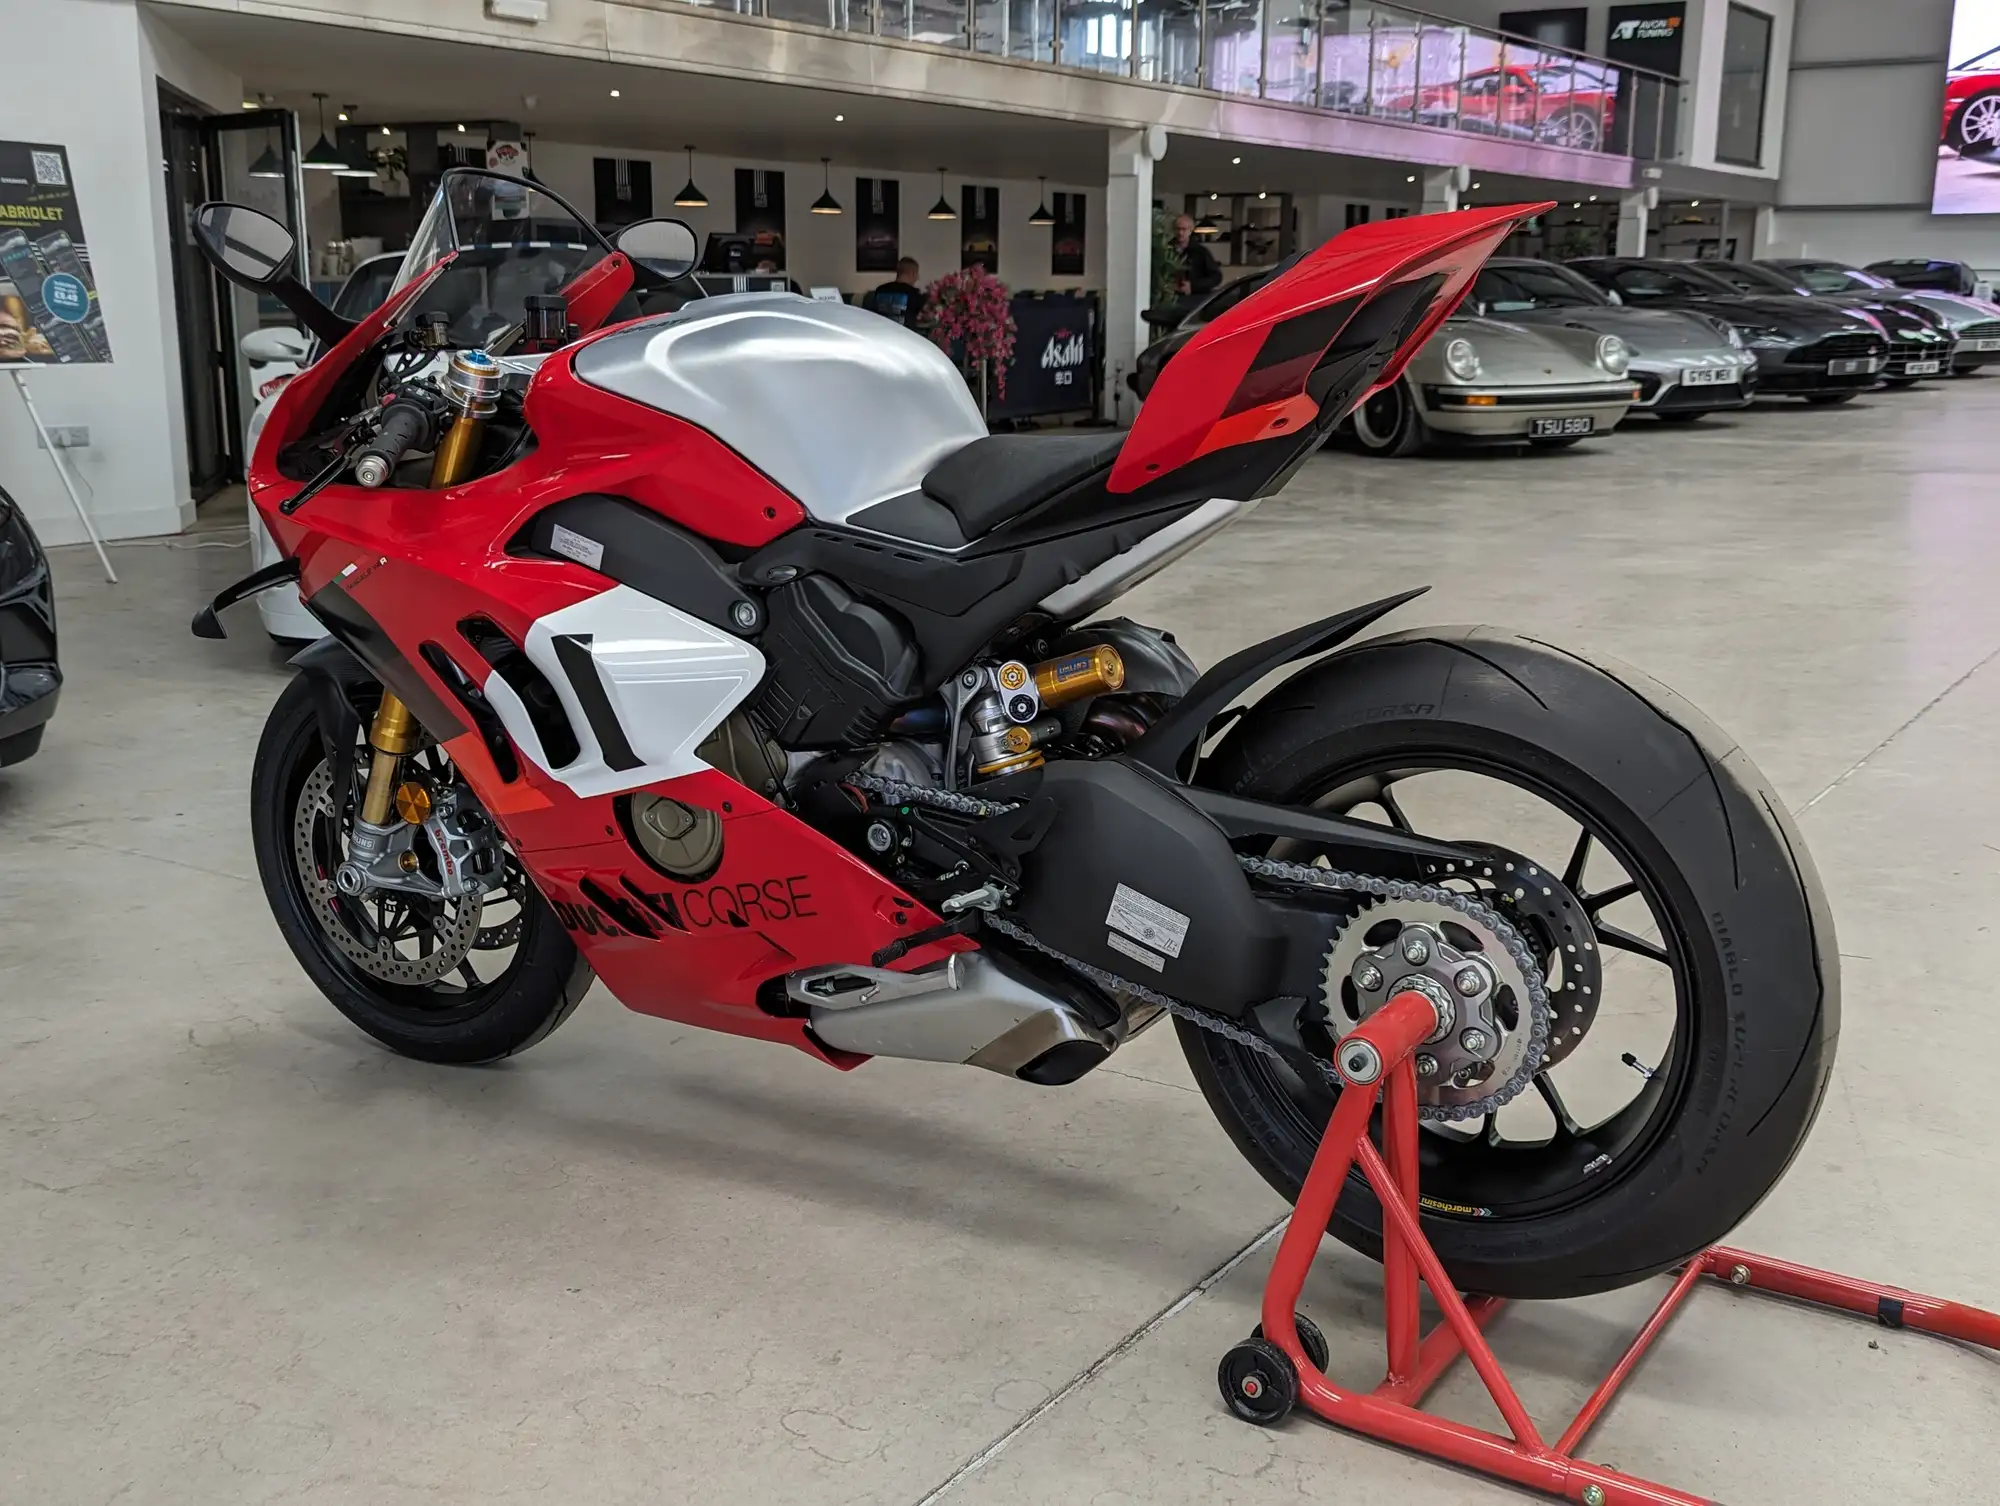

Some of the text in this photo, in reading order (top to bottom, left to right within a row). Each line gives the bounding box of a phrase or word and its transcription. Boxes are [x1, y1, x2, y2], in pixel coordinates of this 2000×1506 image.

[1637, 28, 1674, 39] TUNING
[1041, 333, 1084, 369] Asahi
[434, 828, 454, 876] brembo
[682, 875, 818, 928] CORSE
[1711, 911, 1744, 997] DIABLO
[1420, 1197, 1473, 1214] marchesini
